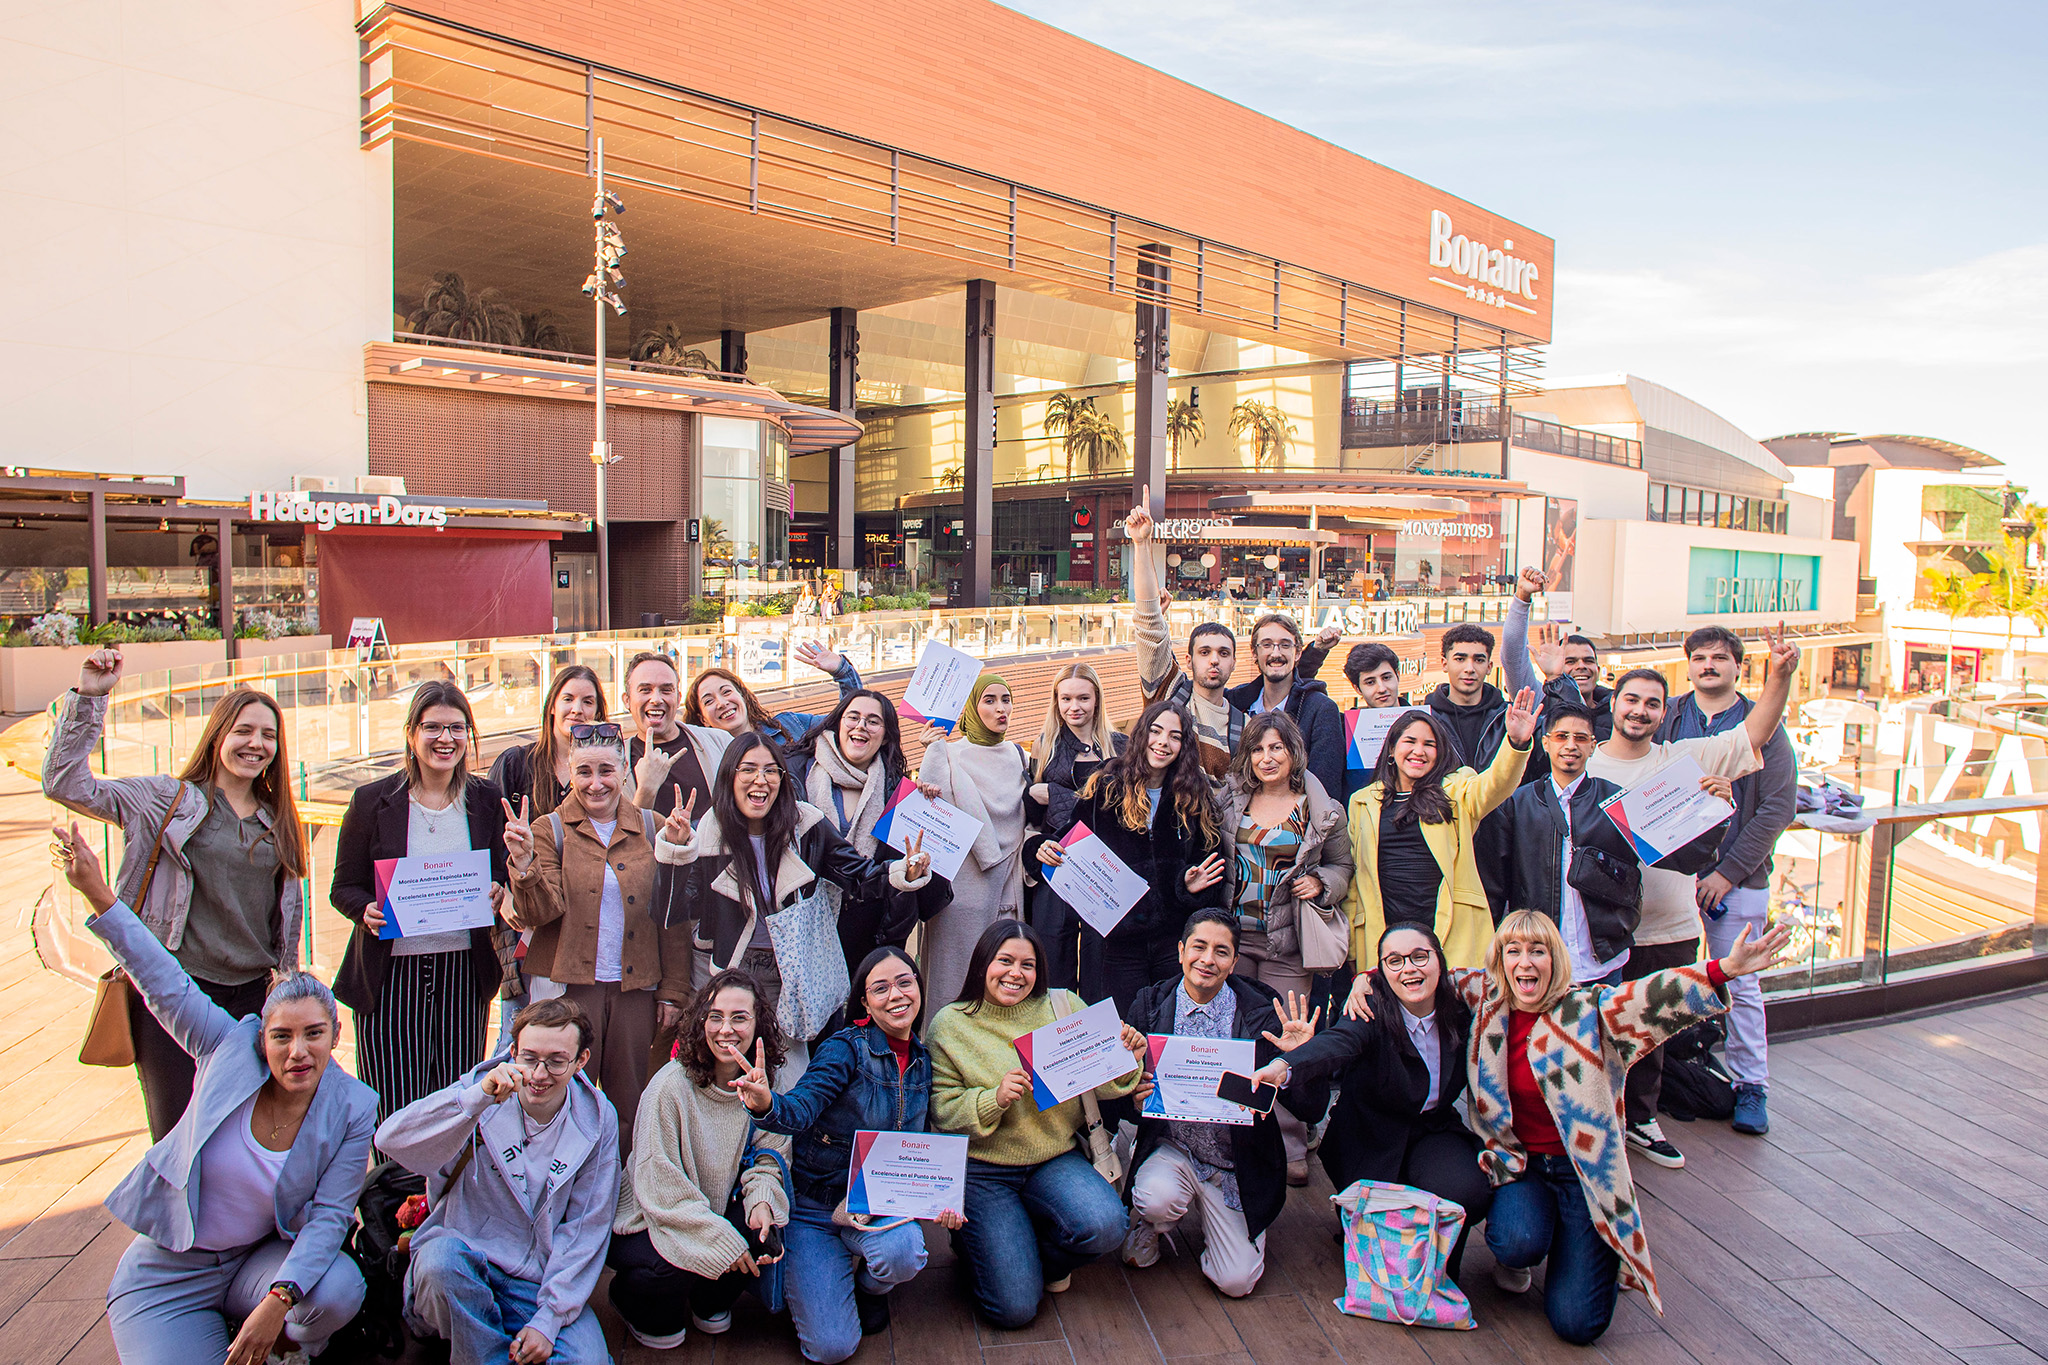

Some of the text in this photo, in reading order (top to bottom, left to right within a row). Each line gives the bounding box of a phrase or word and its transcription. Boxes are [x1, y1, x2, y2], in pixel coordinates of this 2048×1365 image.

[1430, 210, 1538, 300] Bonaire
[250, 490, 447, 530] Häagen-Dazs
[1154, 522, 1201, 538] NEGRO
[1714, 577, 1802, 614] PRIMARK
[1304, 605, 1364, 635] LAS
[1643, 781, 1666, 797] Bonaire
[424, 861, 453, 869] Bonaire
[1100, 853, 1120, 873] Bonaire
[1056, 1020, 1082, 1034] Bonaire
[1043, 1057, 1068, 1070] Excelencia
[1080, 1045, 1094, 1053] Punto
[1101, 1036, 1115, 1044] Venta
[1191, 1045, 1218, 1054] Bonaire
[902, 1140, 930, 1149] Bonaire
